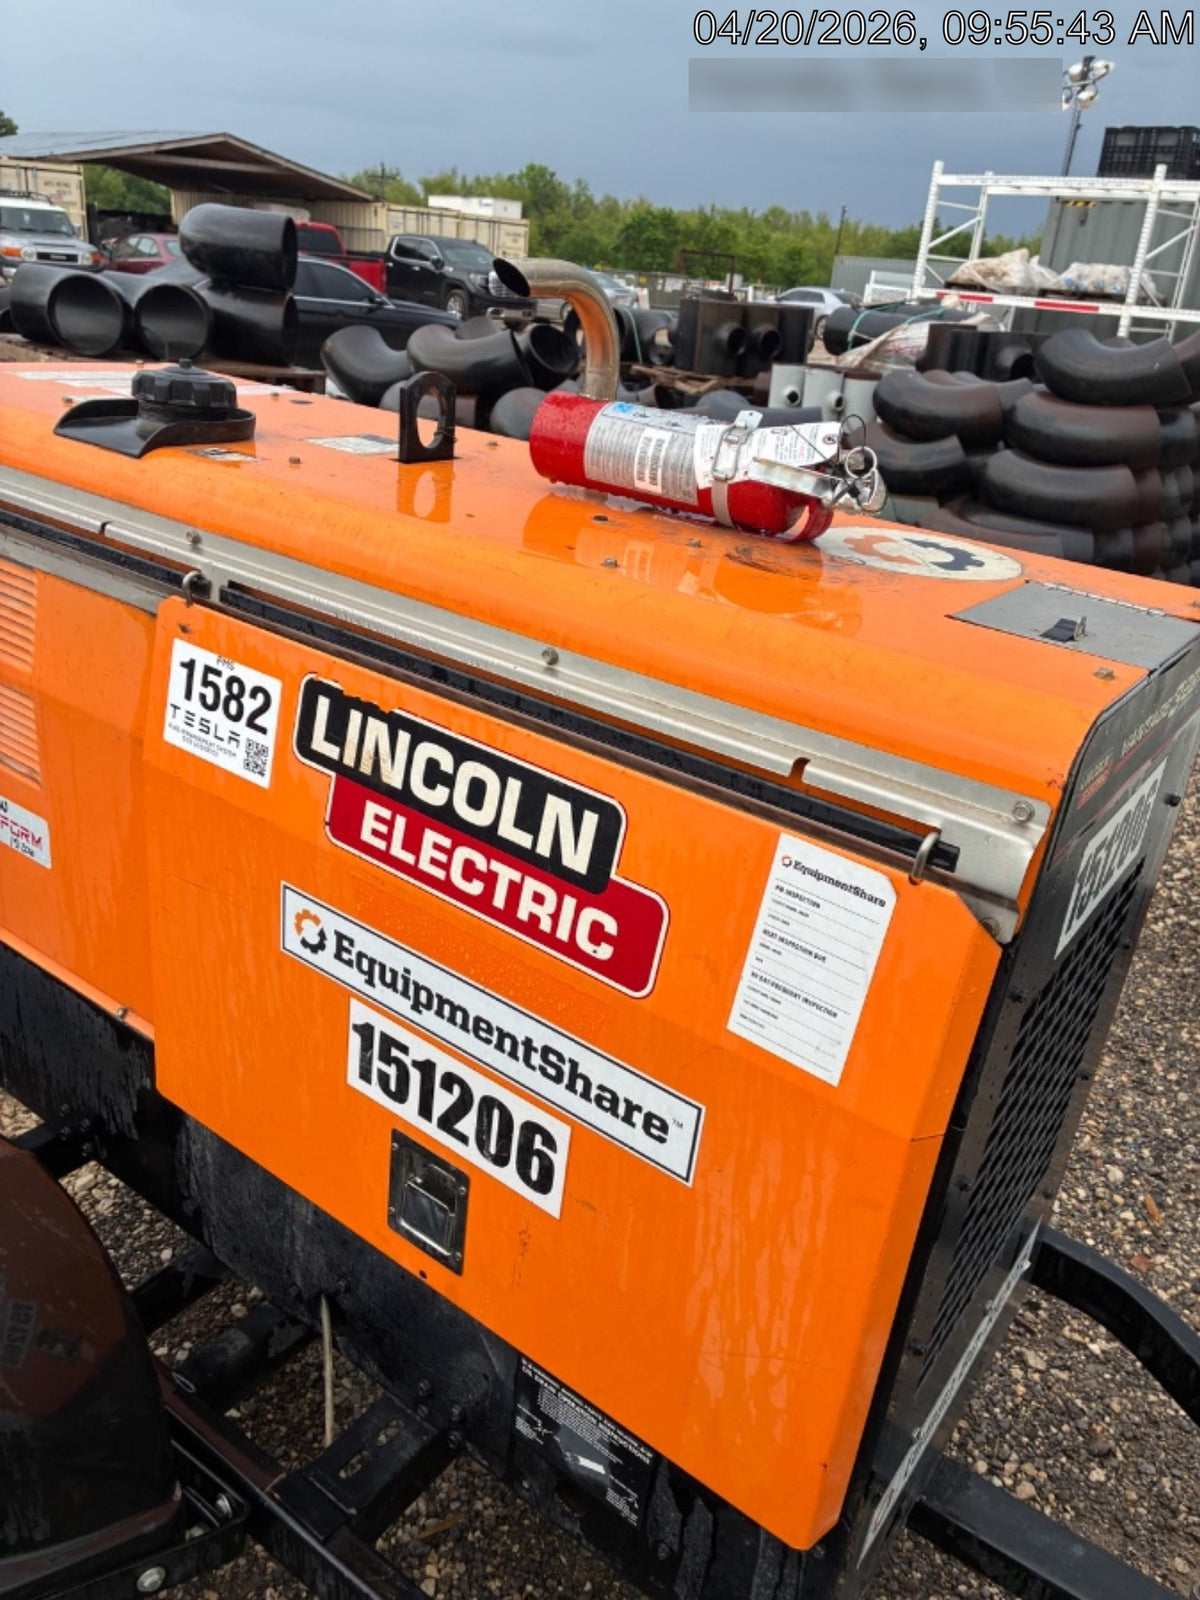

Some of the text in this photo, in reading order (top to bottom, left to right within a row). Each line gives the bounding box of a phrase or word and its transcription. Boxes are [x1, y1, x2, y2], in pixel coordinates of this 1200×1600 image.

[169, 703, 241, 749] TESLA
[179, 657, 272, 736] 1582
[310, 694, 600, 877] LINCOLN
[359, 799, 619, 961] ELECTRIC
[793, 860, 887, 908] EquipmentShare
[333, 929, 670, 1145] EquipmentShare
[351, 1021, 558, 1196] 151206
